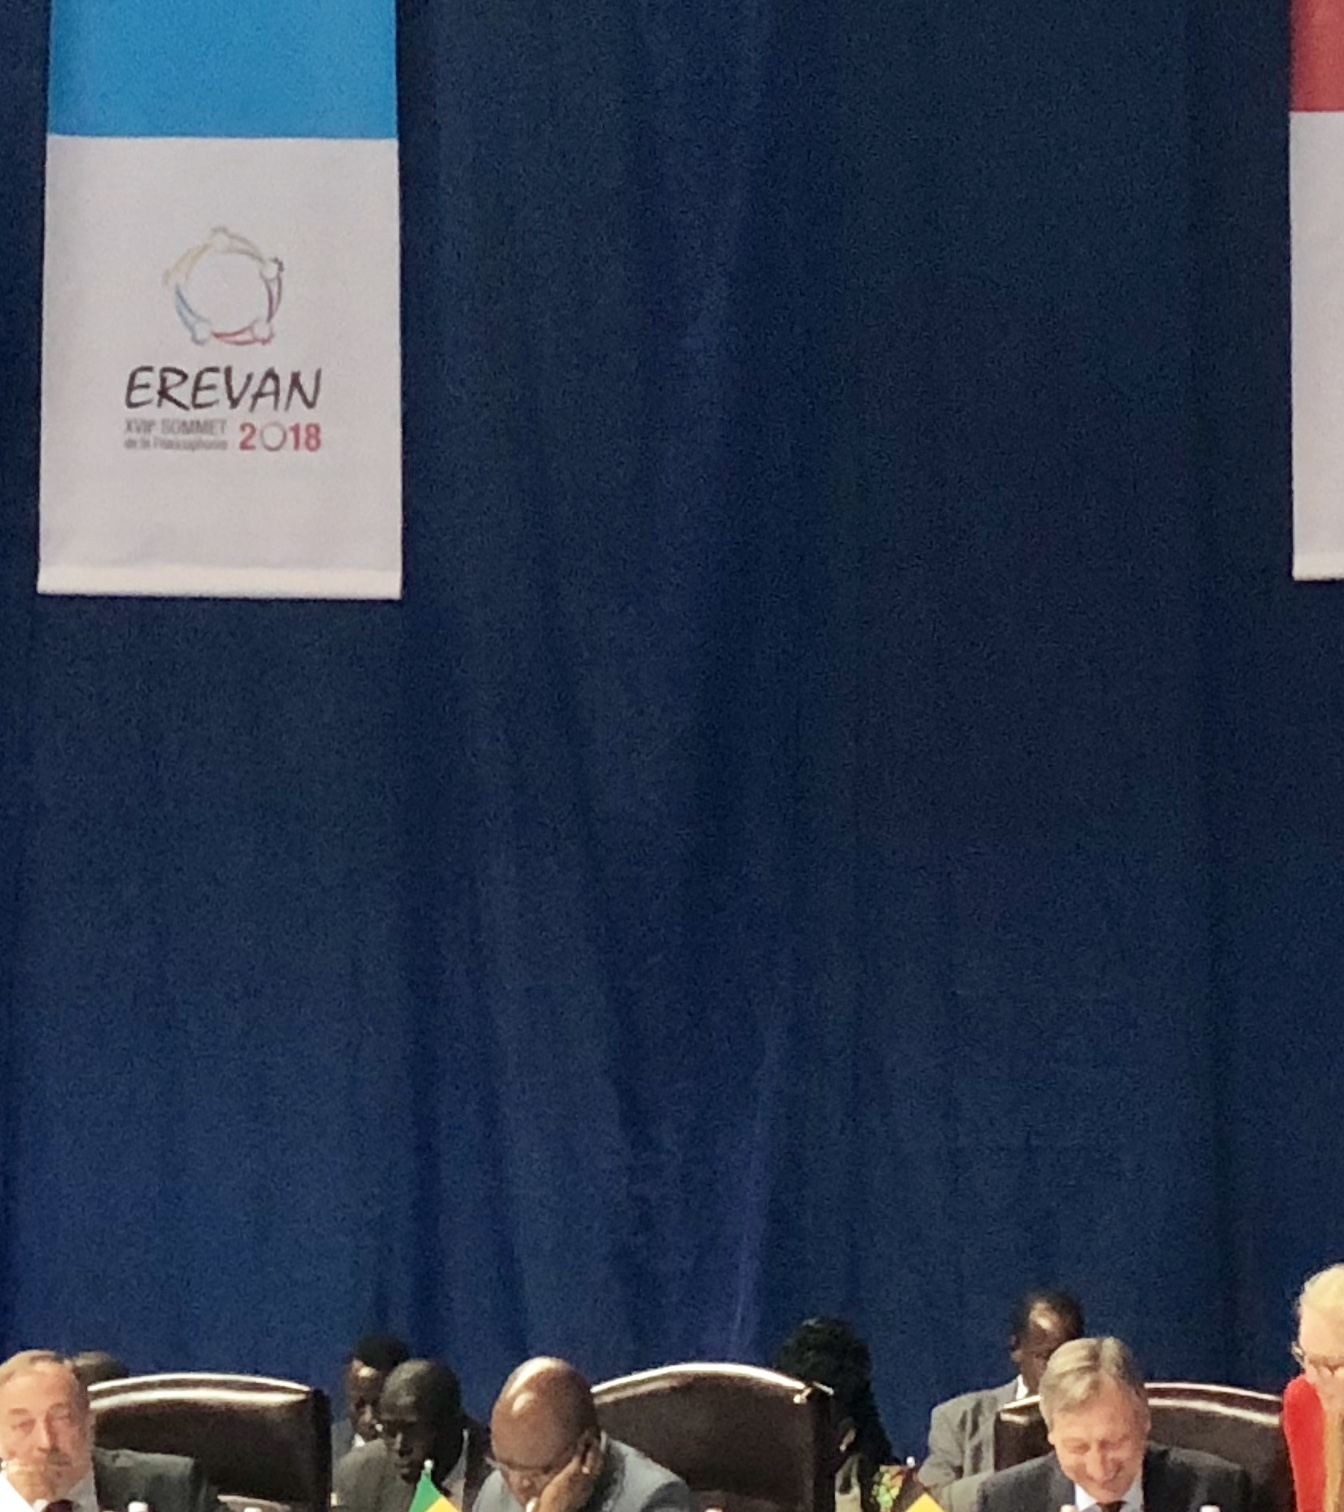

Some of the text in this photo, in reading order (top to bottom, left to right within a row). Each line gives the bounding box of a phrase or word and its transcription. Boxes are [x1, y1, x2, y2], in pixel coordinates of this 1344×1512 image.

[125, 365, 321, 413] EREVAN
[161, 418, 228, 435] SOMMET
[239, 421, 321, 452] 2018
